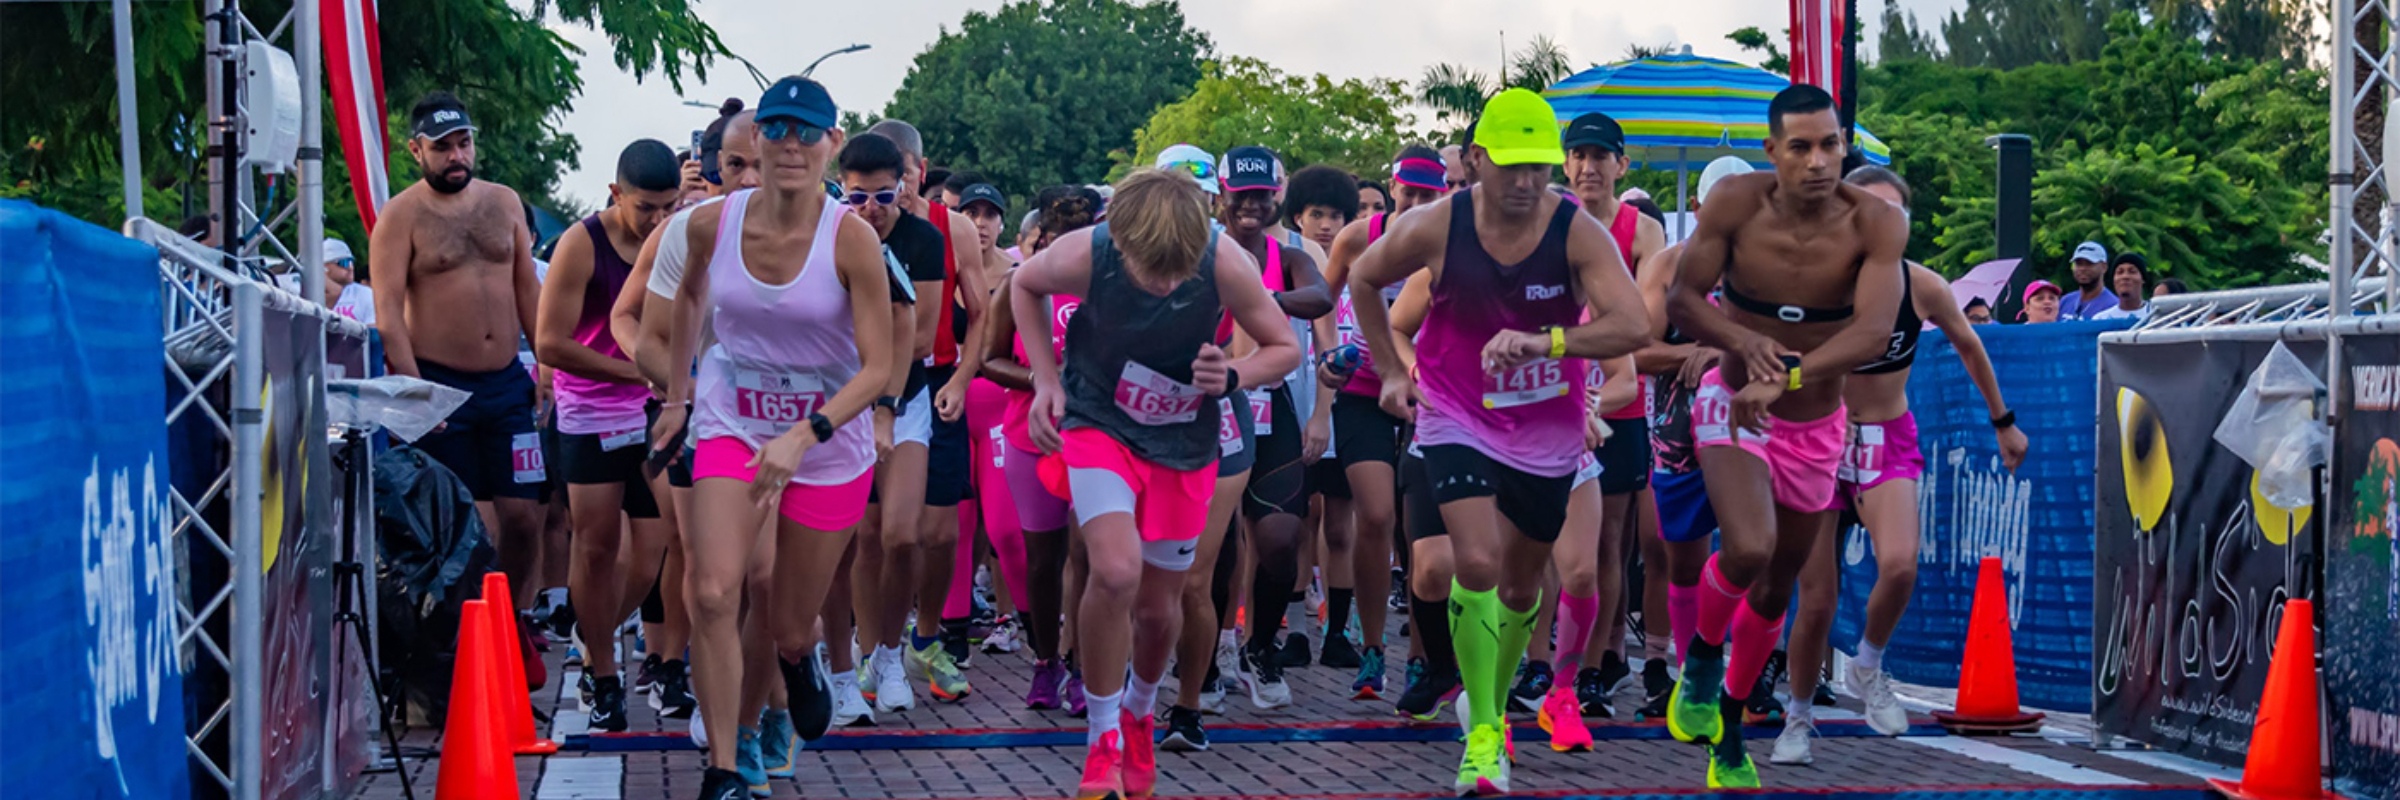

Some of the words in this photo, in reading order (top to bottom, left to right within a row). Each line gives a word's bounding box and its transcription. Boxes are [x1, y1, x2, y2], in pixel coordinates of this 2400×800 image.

[1495, 361, 1562, 392] 1415
[745, 391, 817, 421] 1657
[1126, 385, 1198, 414] 1637
